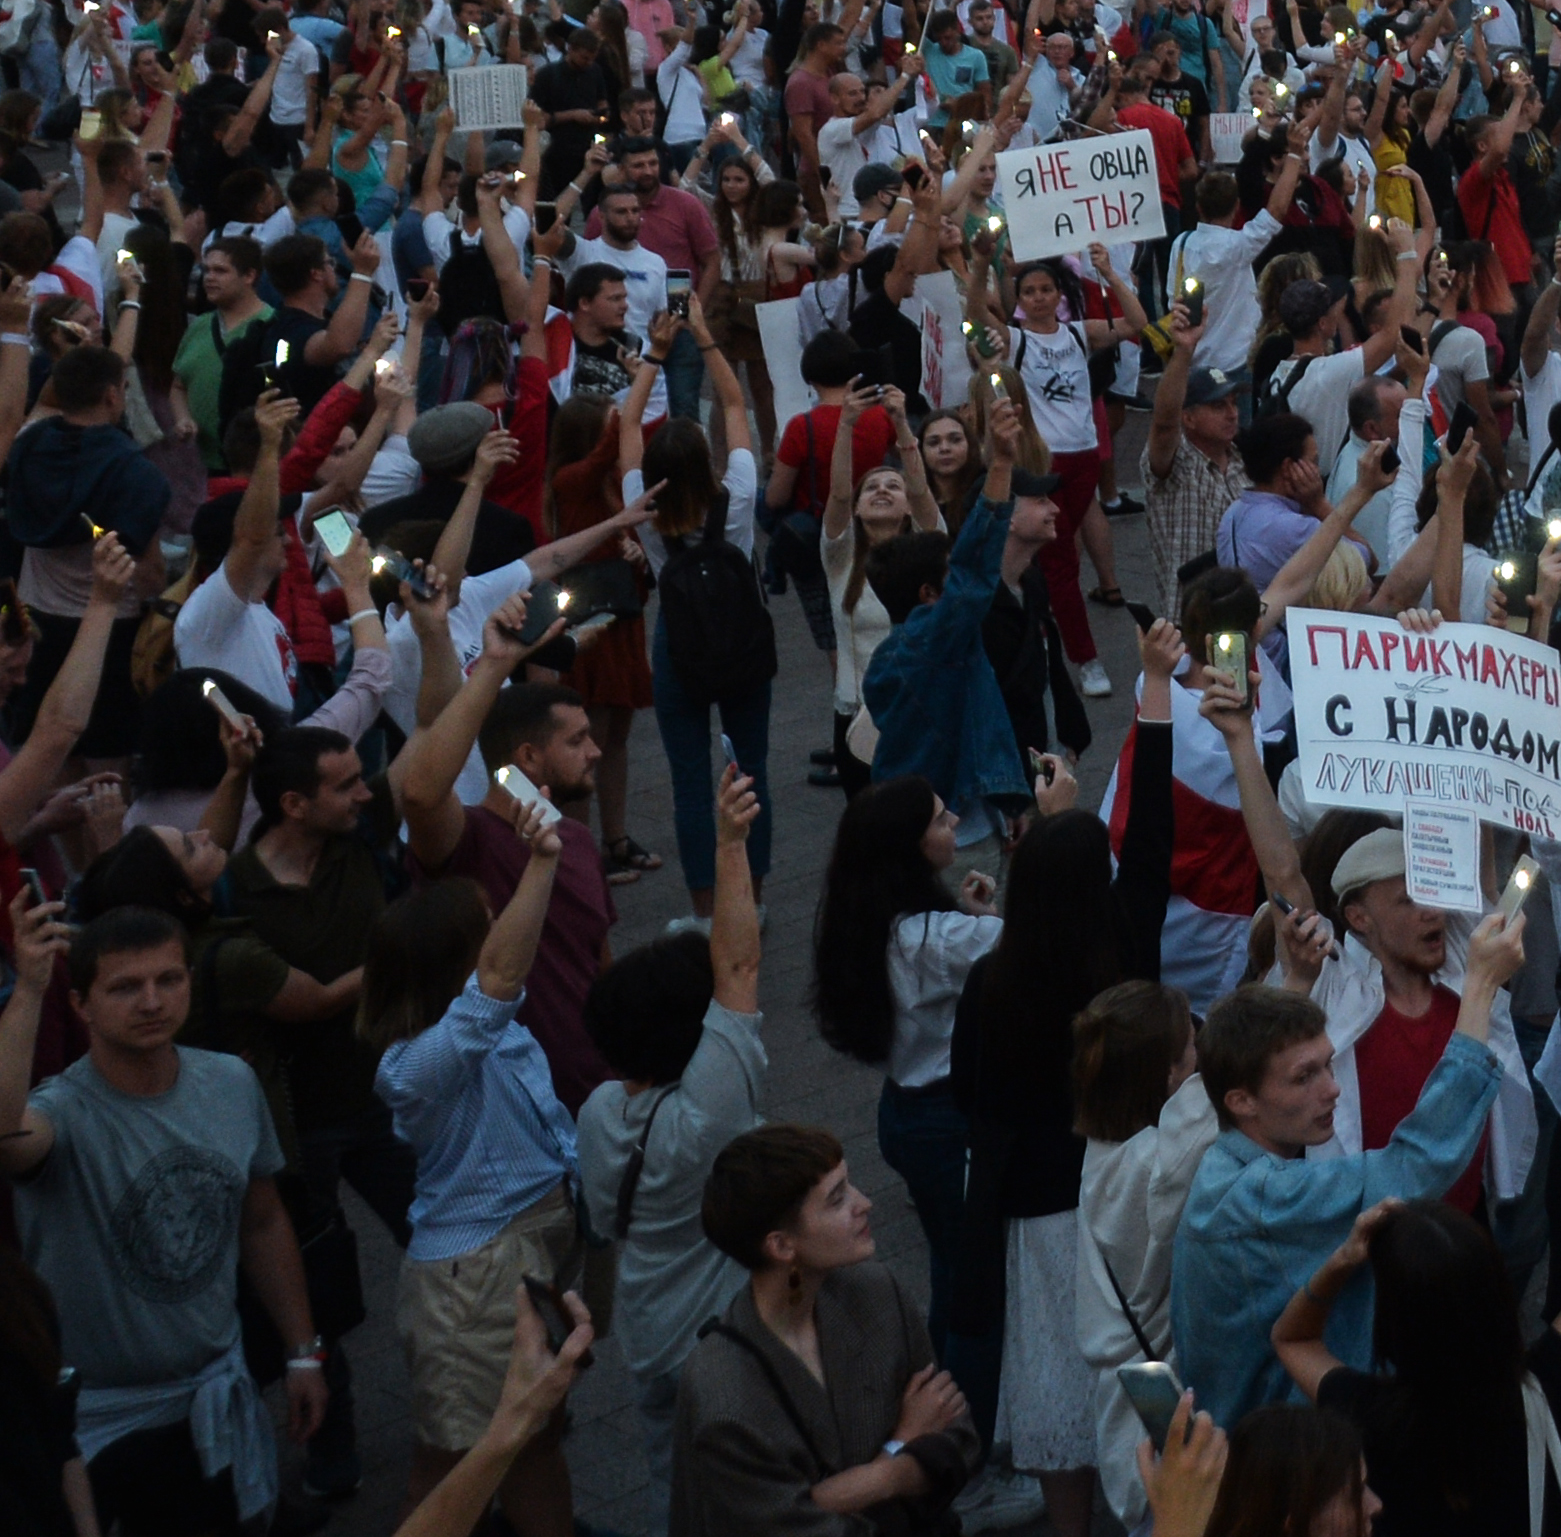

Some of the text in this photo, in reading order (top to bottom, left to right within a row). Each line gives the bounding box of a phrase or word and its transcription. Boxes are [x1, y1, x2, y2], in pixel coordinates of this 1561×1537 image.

[1015, 144, 1150, 198] Я НЕ ОВЦА
[1073, 190, 1145, 232] ТЫ?
[1306, 624, 1560, 708] ПАРИКМАХЕРЫ
[1325, 694, 1560, 780] С НАРОДОМ
